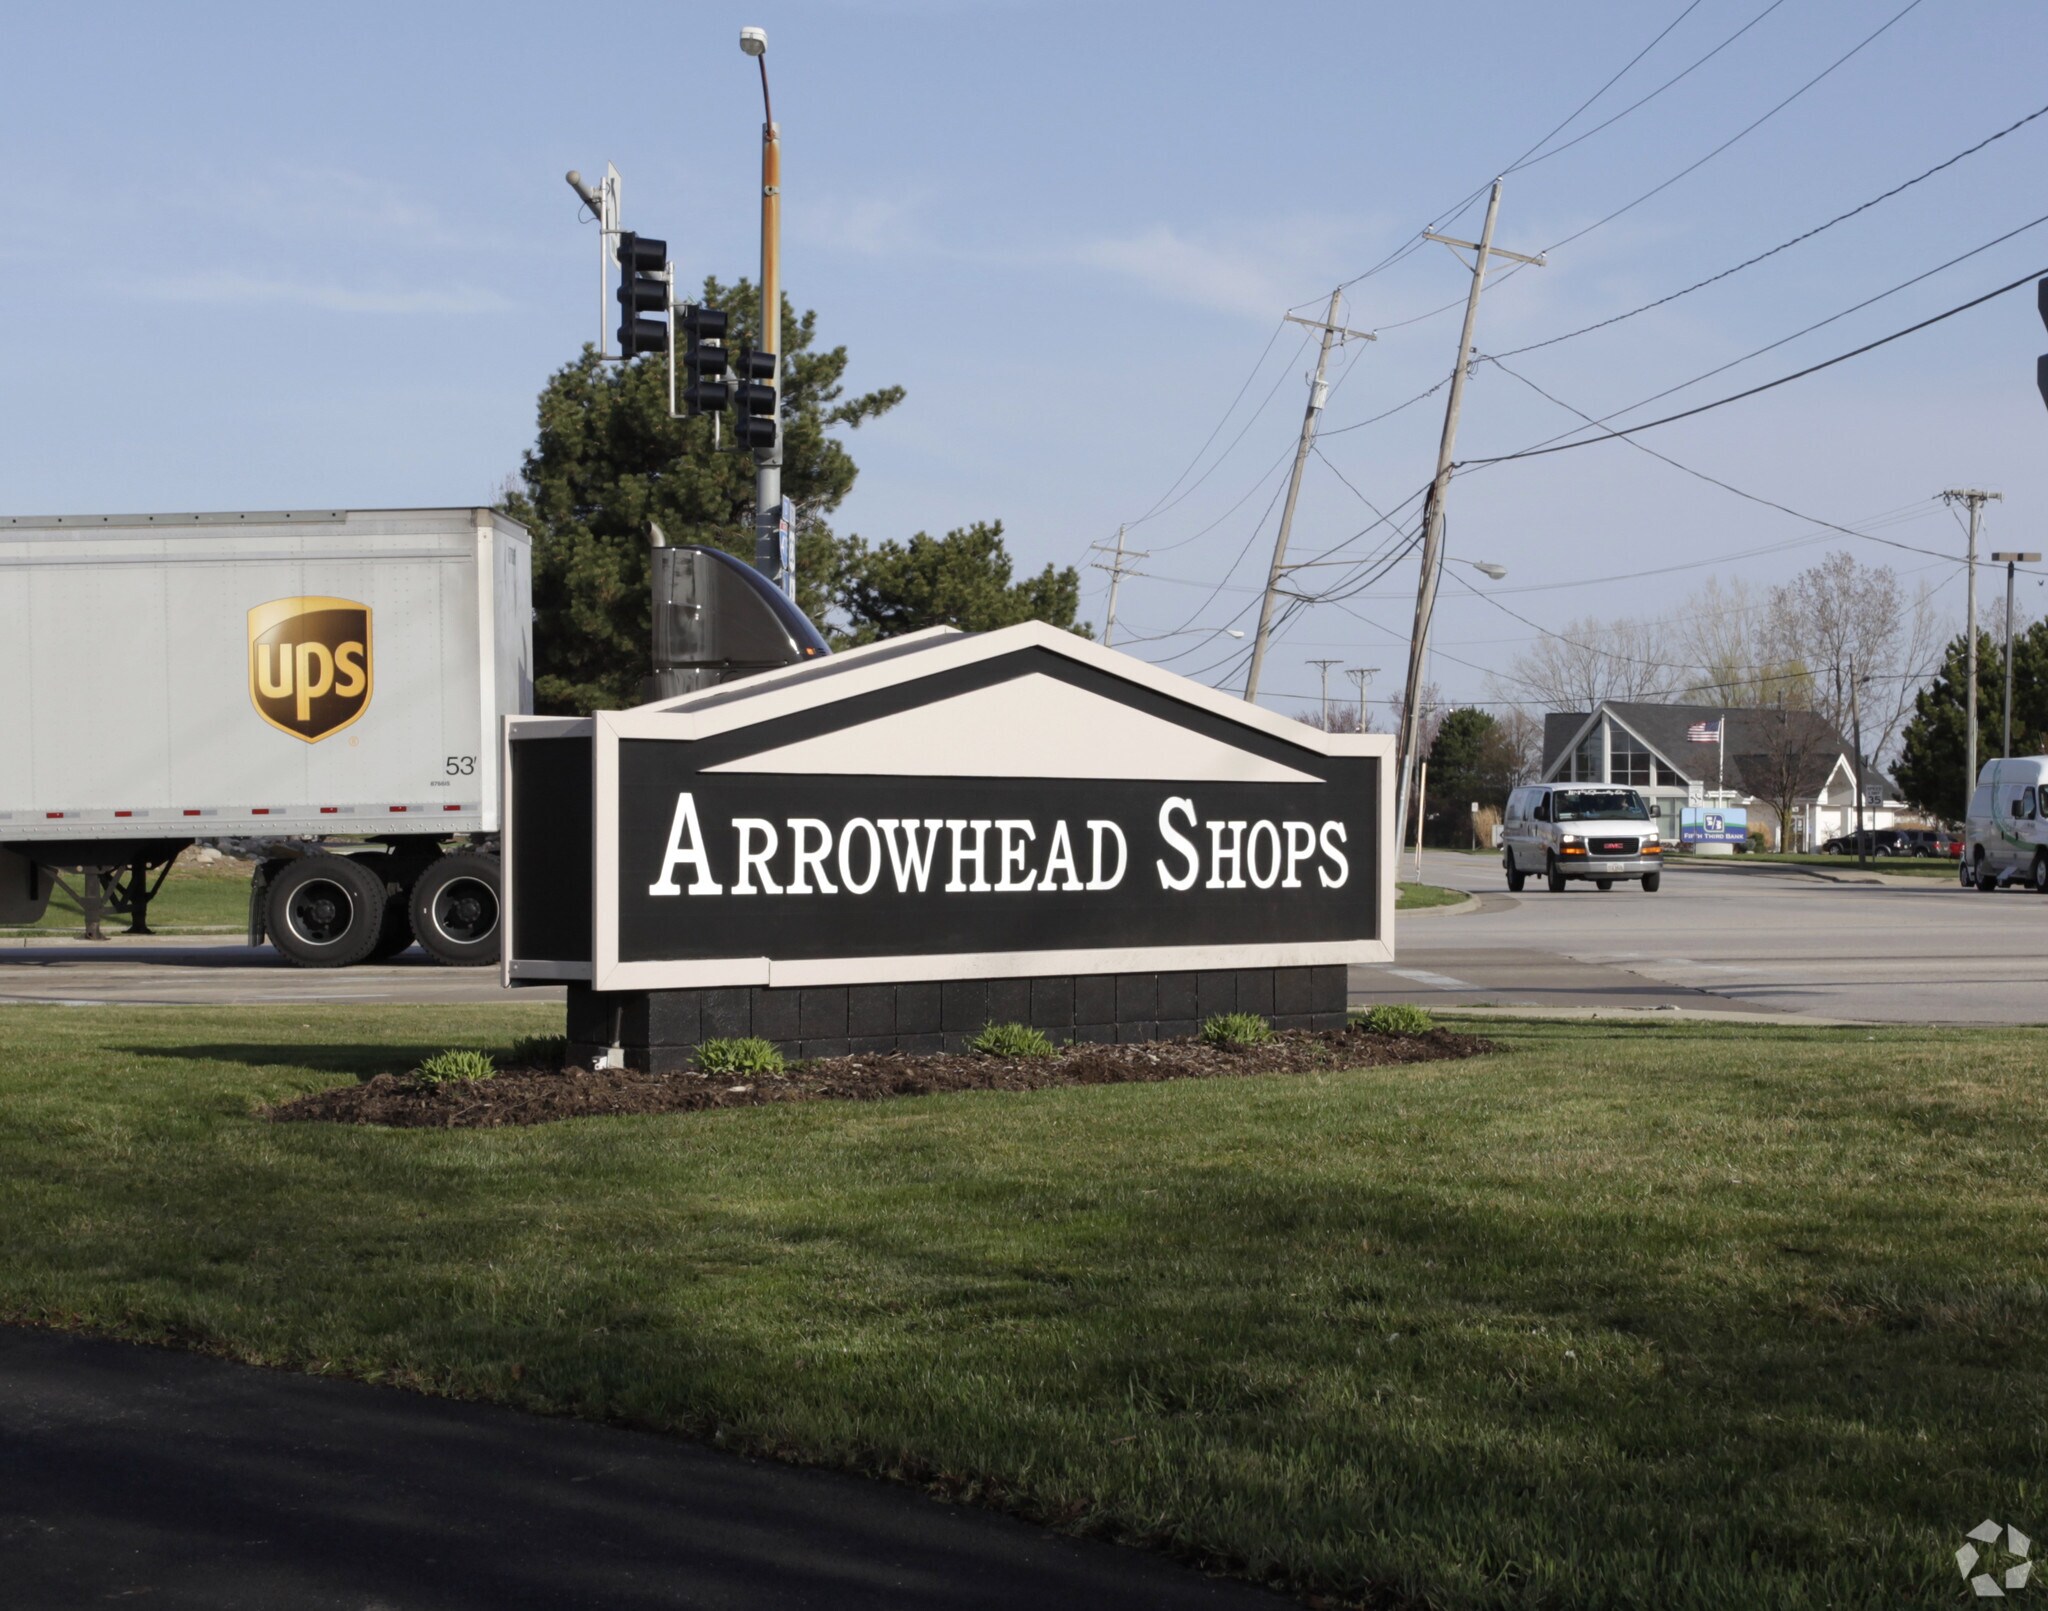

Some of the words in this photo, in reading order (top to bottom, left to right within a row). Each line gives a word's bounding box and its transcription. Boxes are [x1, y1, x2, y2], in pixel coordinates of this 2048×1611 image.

[258, 641, 366, 721] ups
[1868, 795, 1881, 804] 35
[649, 792, 1128, 895] ARROWHEAD
[1156, 796, 1349, 891] SHOPS
